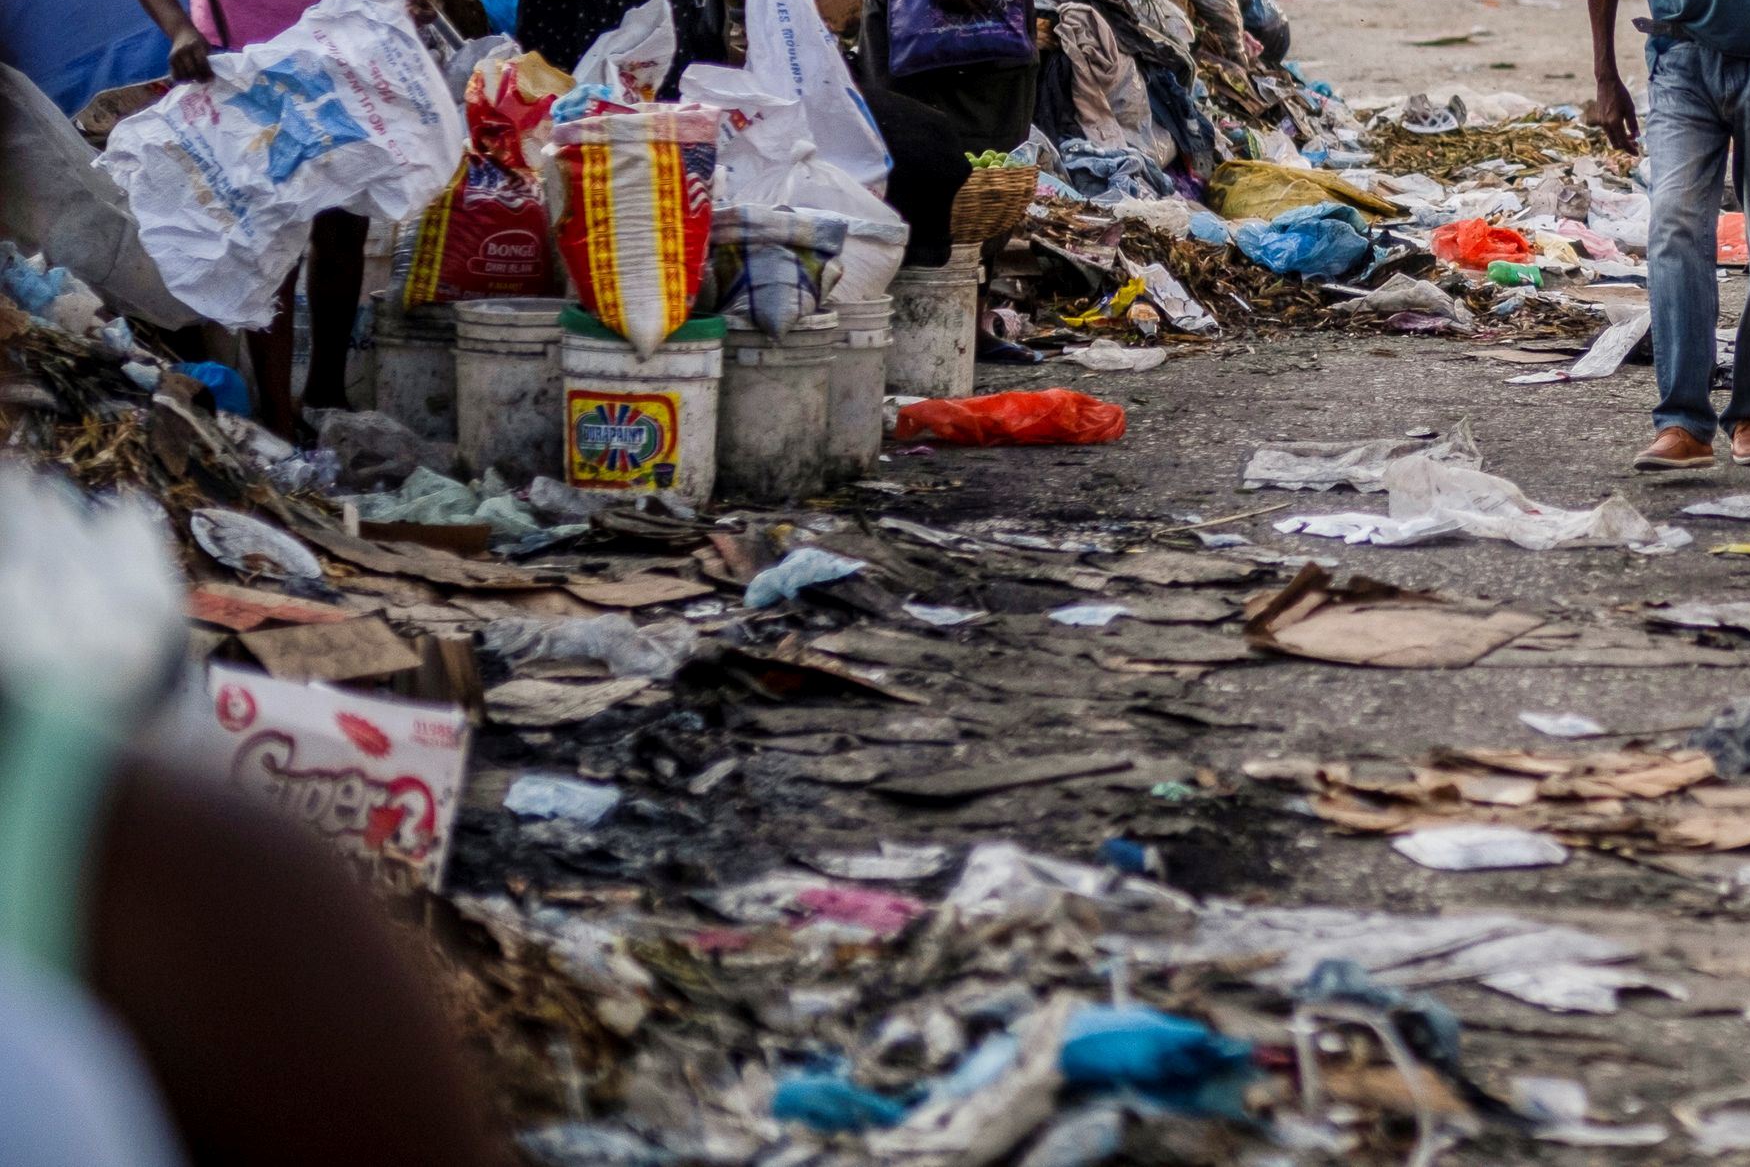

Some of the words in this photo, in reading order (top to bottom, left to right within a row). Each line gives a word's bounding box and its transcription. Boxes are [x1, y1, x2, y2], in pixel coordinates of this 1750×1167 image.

[776, 2, 791, 23] LES
[782, 28, 804, 84] MOULINS
[342, 70, 388, 137] MOULINS
